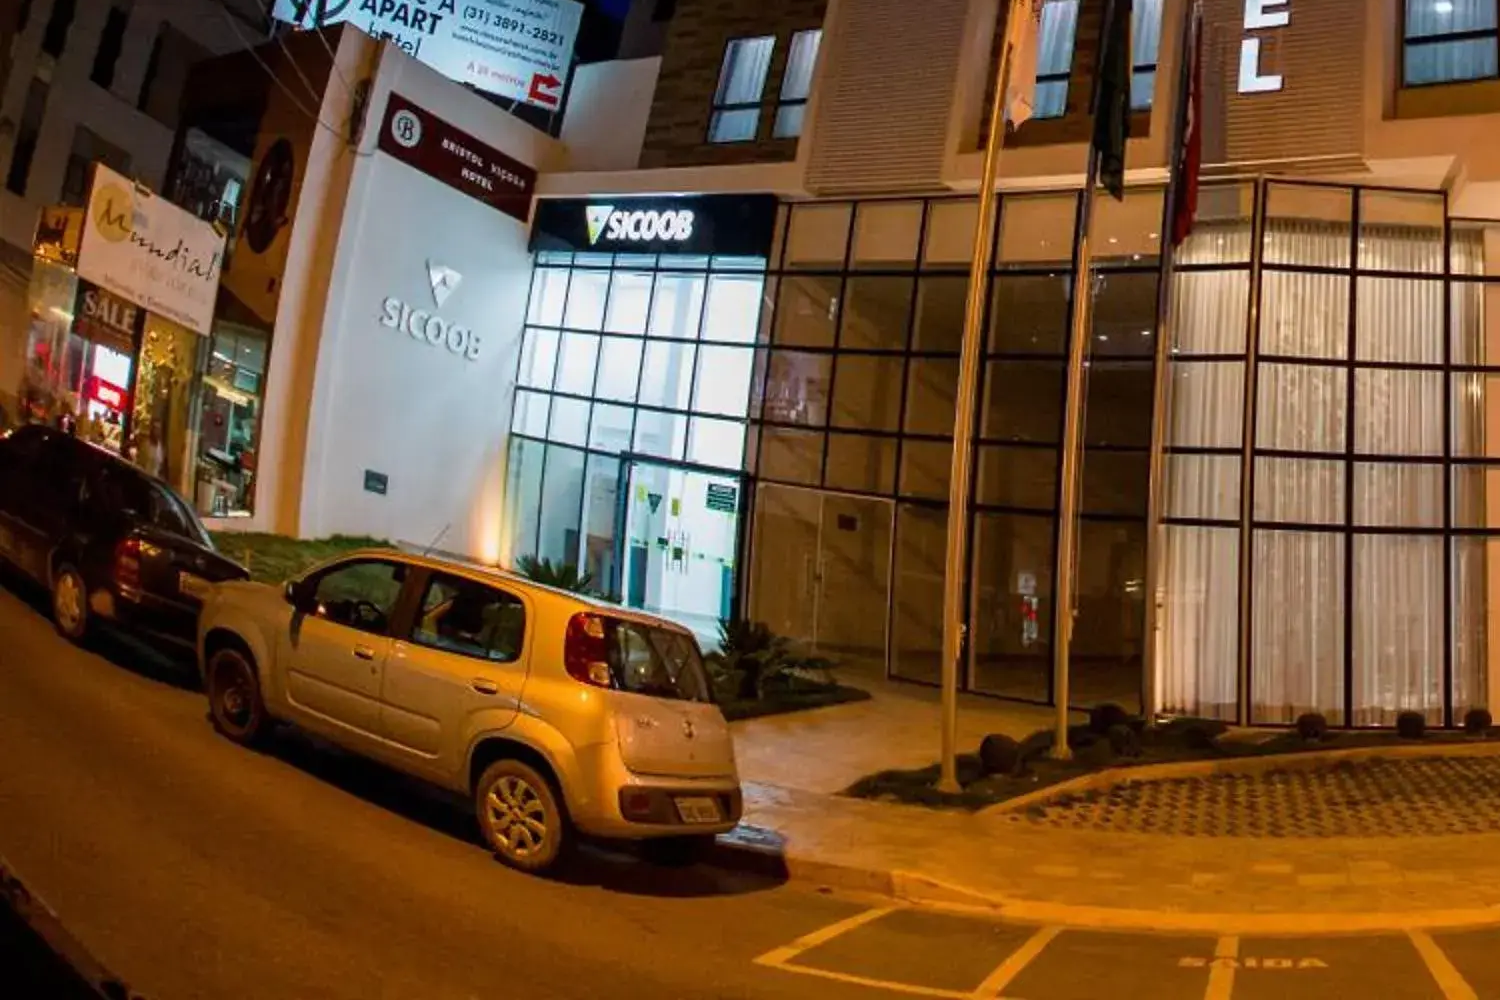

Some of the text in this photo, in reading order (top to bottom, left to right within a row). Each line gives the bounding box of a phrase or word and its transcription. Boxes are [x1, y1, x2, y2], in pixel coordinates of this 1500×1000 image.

[368, 20, 424, 58] htel
[463, 5, 490, 26] (31)
[493, 15, 565, 46] 3891-2821
[441, 137, 484, 168] BRISTOL
[461, 167, 493, 192] HOTEL
[97, 197, 221, 282] Mundial
[606, 209, 696, 241] SICOOB
[84, 290, 136, 333] SALE
[379, 296, 482, 361] SICOOB
